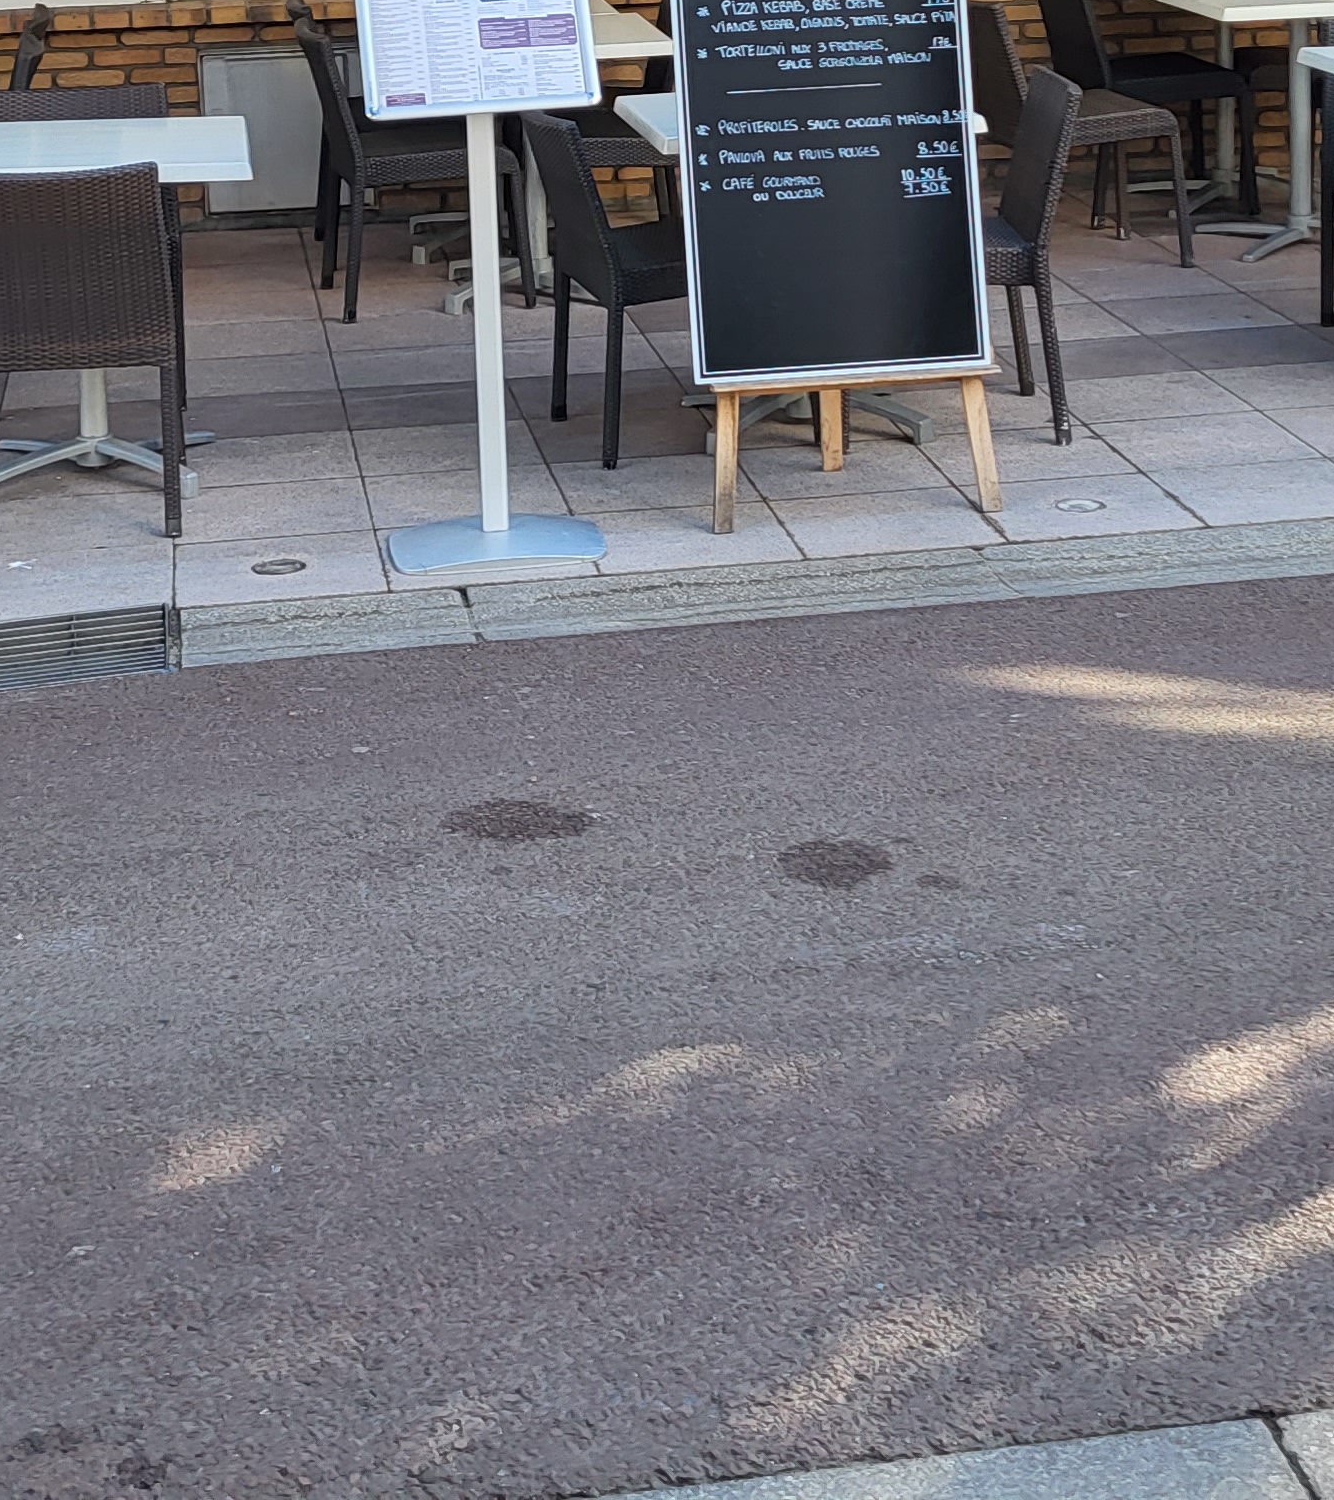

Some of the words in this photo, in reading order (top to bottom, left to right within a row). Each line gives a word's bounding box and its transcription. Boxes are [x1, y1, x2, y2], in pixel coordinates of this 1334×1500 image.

[816, 41, 828, 54] 3
[722, 173, 755, 190] CAFÉ
[752, 190, 769, 202] OU
